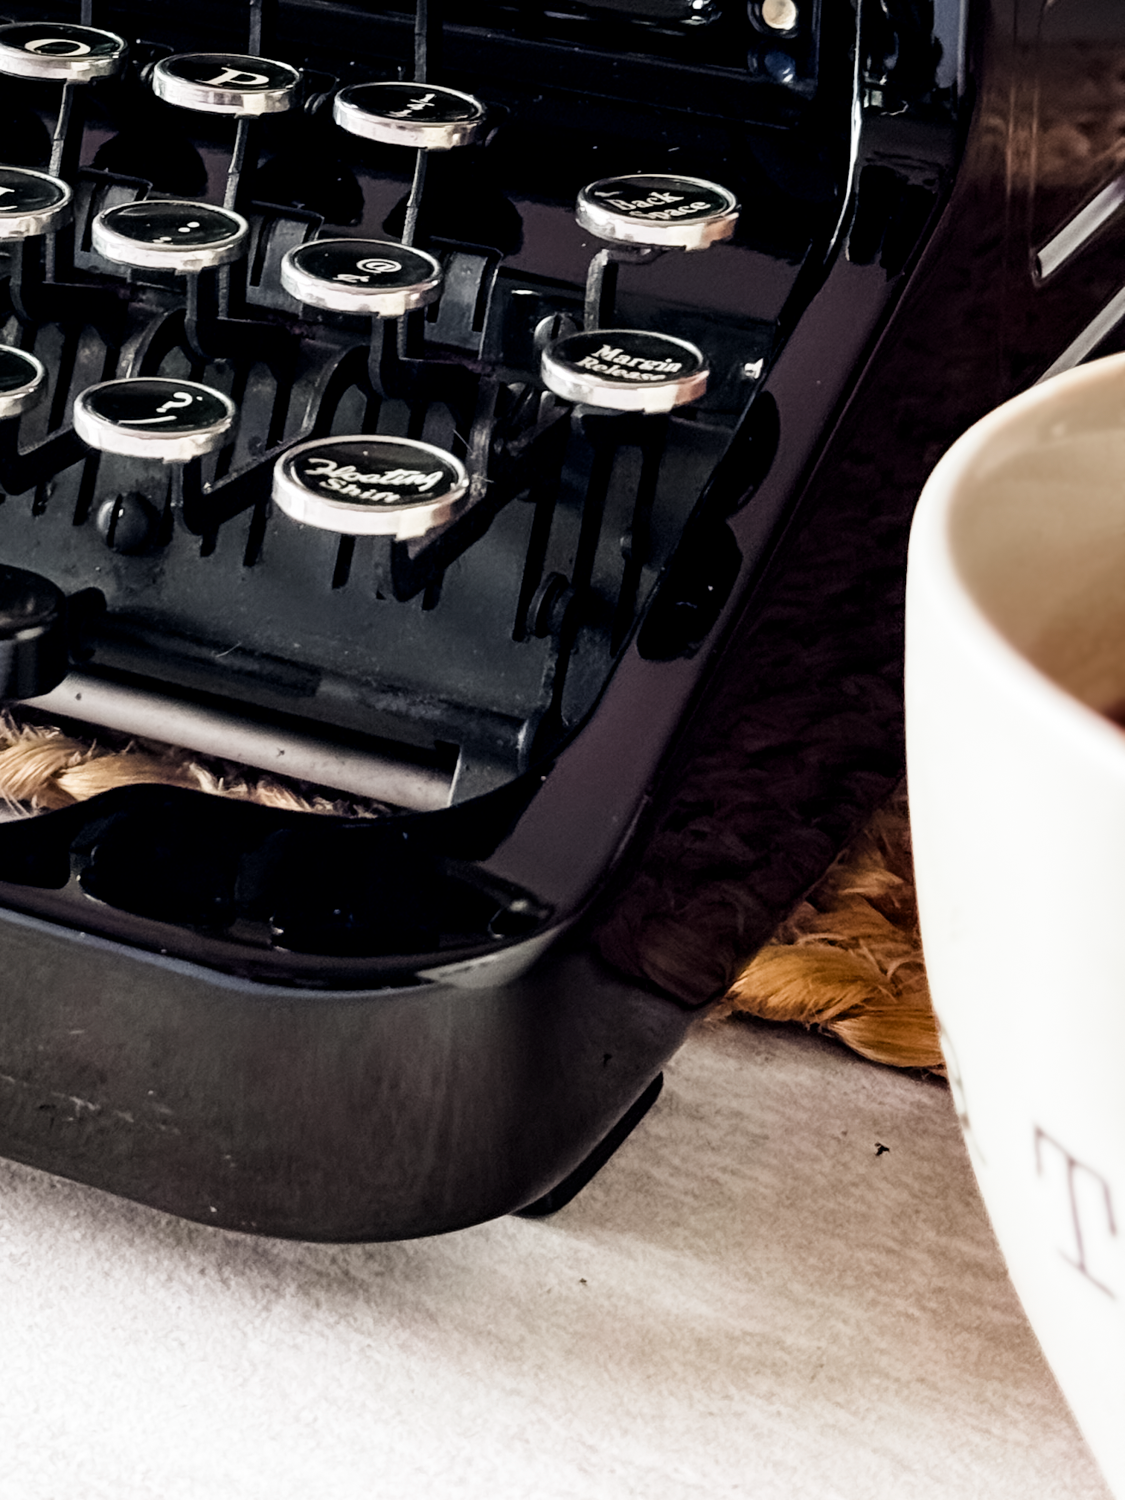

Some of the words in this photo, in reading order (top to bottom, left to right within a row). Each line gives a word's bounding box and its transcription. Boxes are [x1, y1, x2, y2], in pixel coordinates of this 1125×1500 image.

[24, 37, 92, 57] O
[205, 67, 270, 89] P
[604, 191, 686, 211] Back
[628, 201, 712, 221] Space
[575, 356, 668, 382] Release
[590, 344, 684, 373] Margin
[304, 457, 445, 493] Floating
[319, 478, 402, 504] Shift
